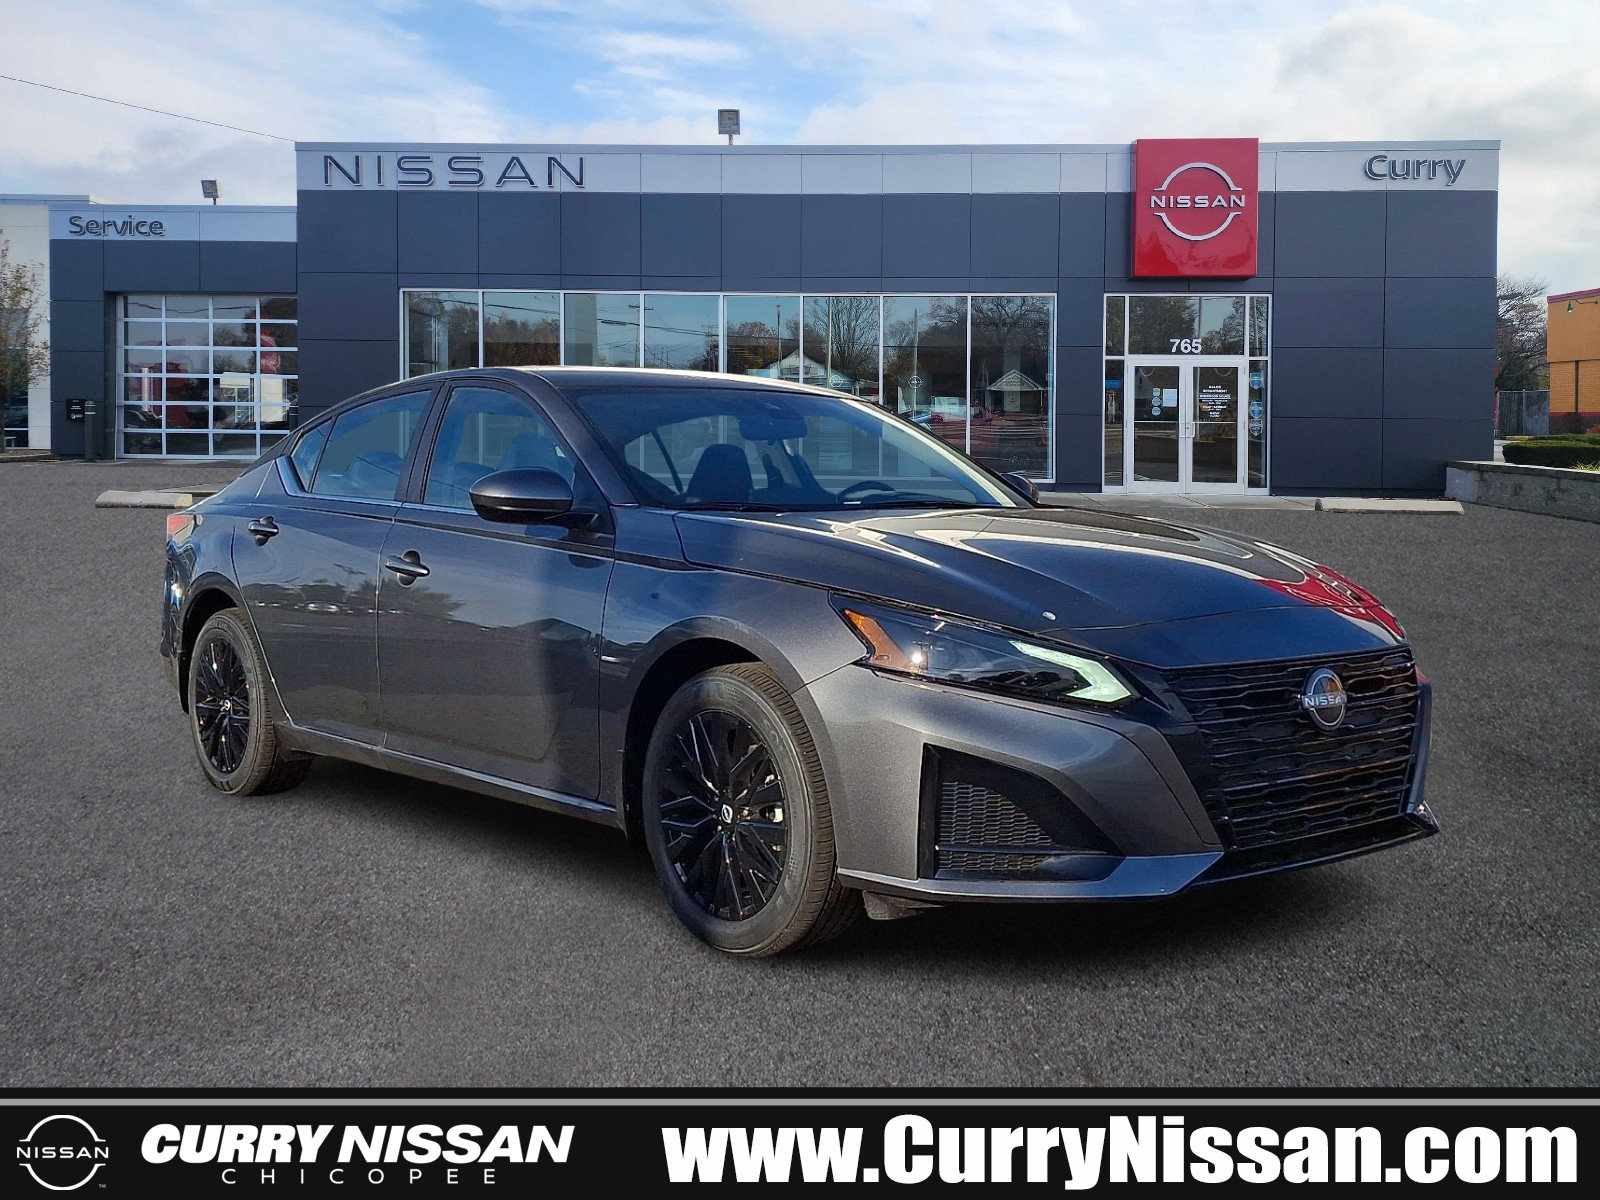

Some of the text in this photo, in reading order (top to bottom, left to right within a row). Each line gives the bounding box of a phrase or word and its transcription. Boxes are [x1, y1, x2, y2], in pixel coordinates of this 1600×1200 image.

[323, 155, 585, 188] NISSAN
[1365, 154, 1467, 186] Curry
[1150, 194, 1246, 208] NISSAN
[68, 214, 165, 236] Service
[1169, 338, 1202, 354] 765
